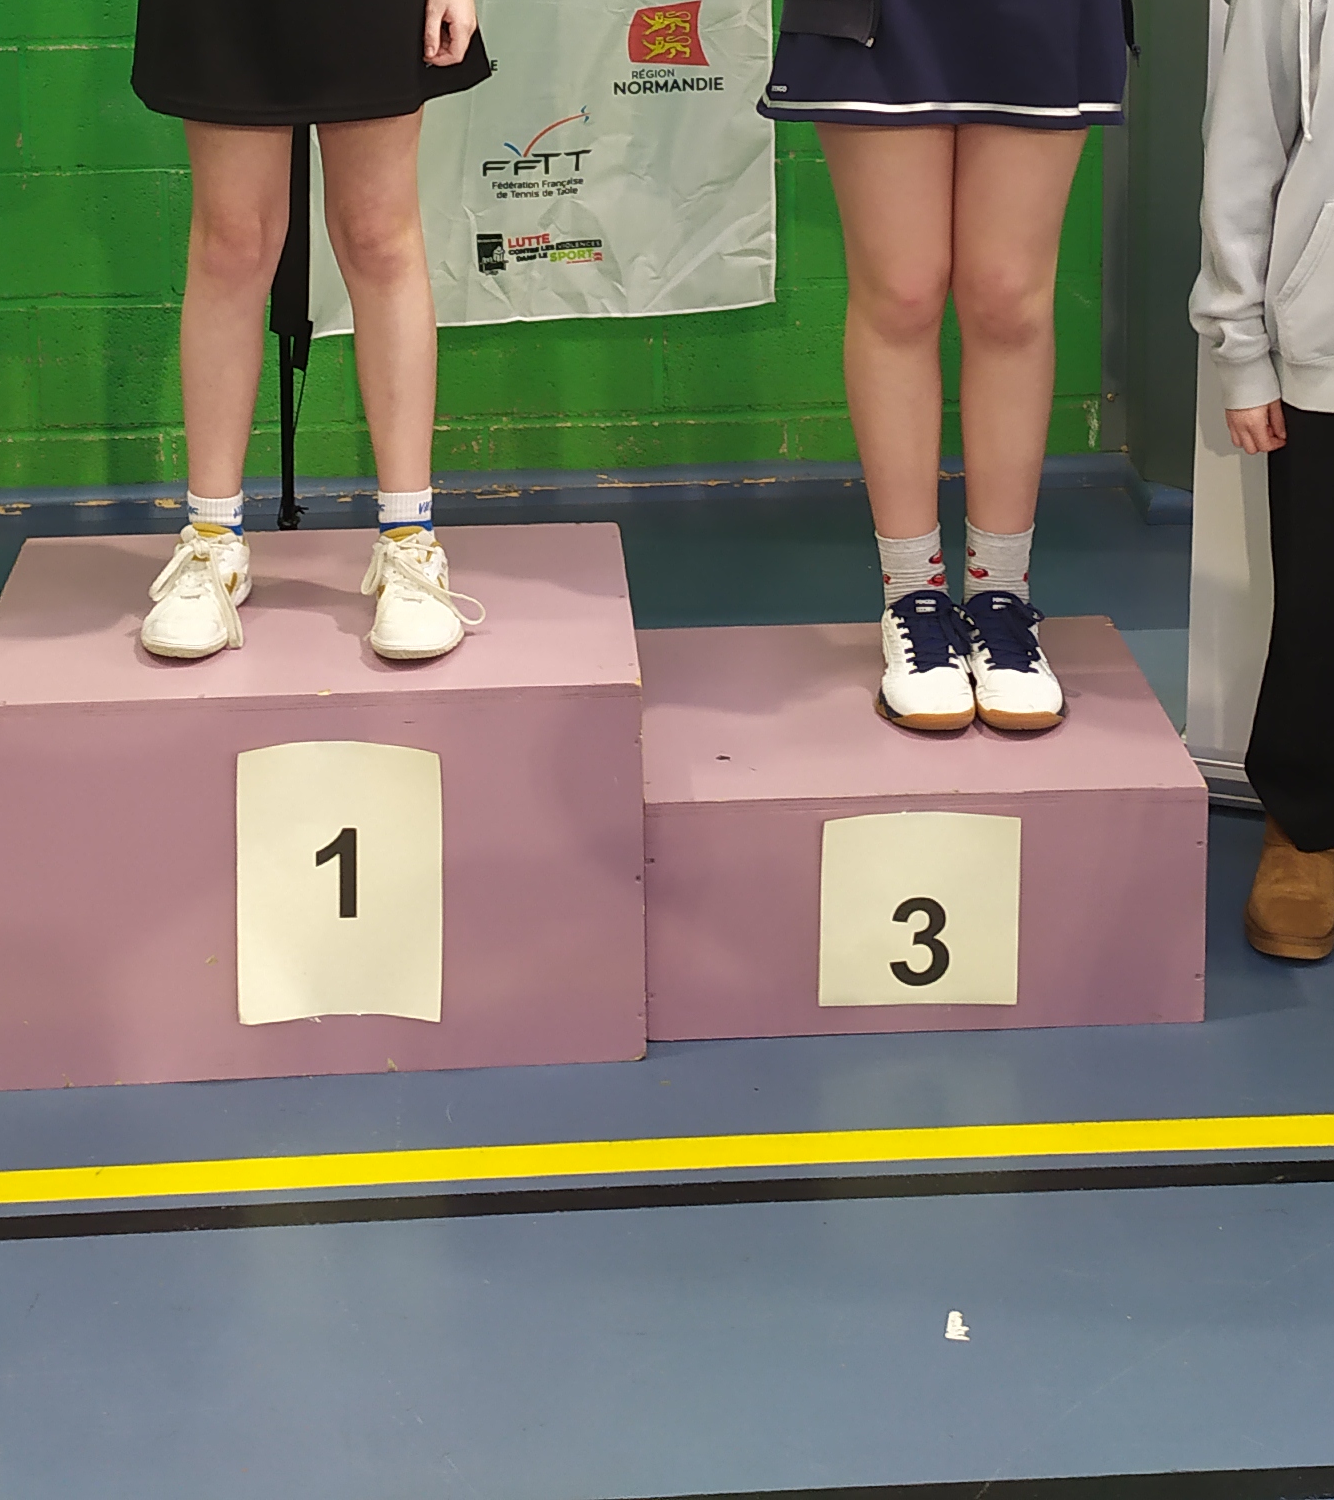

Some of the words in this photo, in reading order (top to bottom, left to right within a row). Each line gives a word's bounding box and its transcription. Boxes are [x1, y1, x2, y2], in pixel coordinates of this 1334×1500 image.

[632, 69, 674, 79] RÉGION
[614, 77, 724, 95] NORMANDIE
[483, 150, 592, 177] FFTT
[508, 233, 550, 248] LUTTE
[549, 249, 594, 262] SPORT
[313, 826, 358, 920] 1
[888, 896, 951, 988] 3
